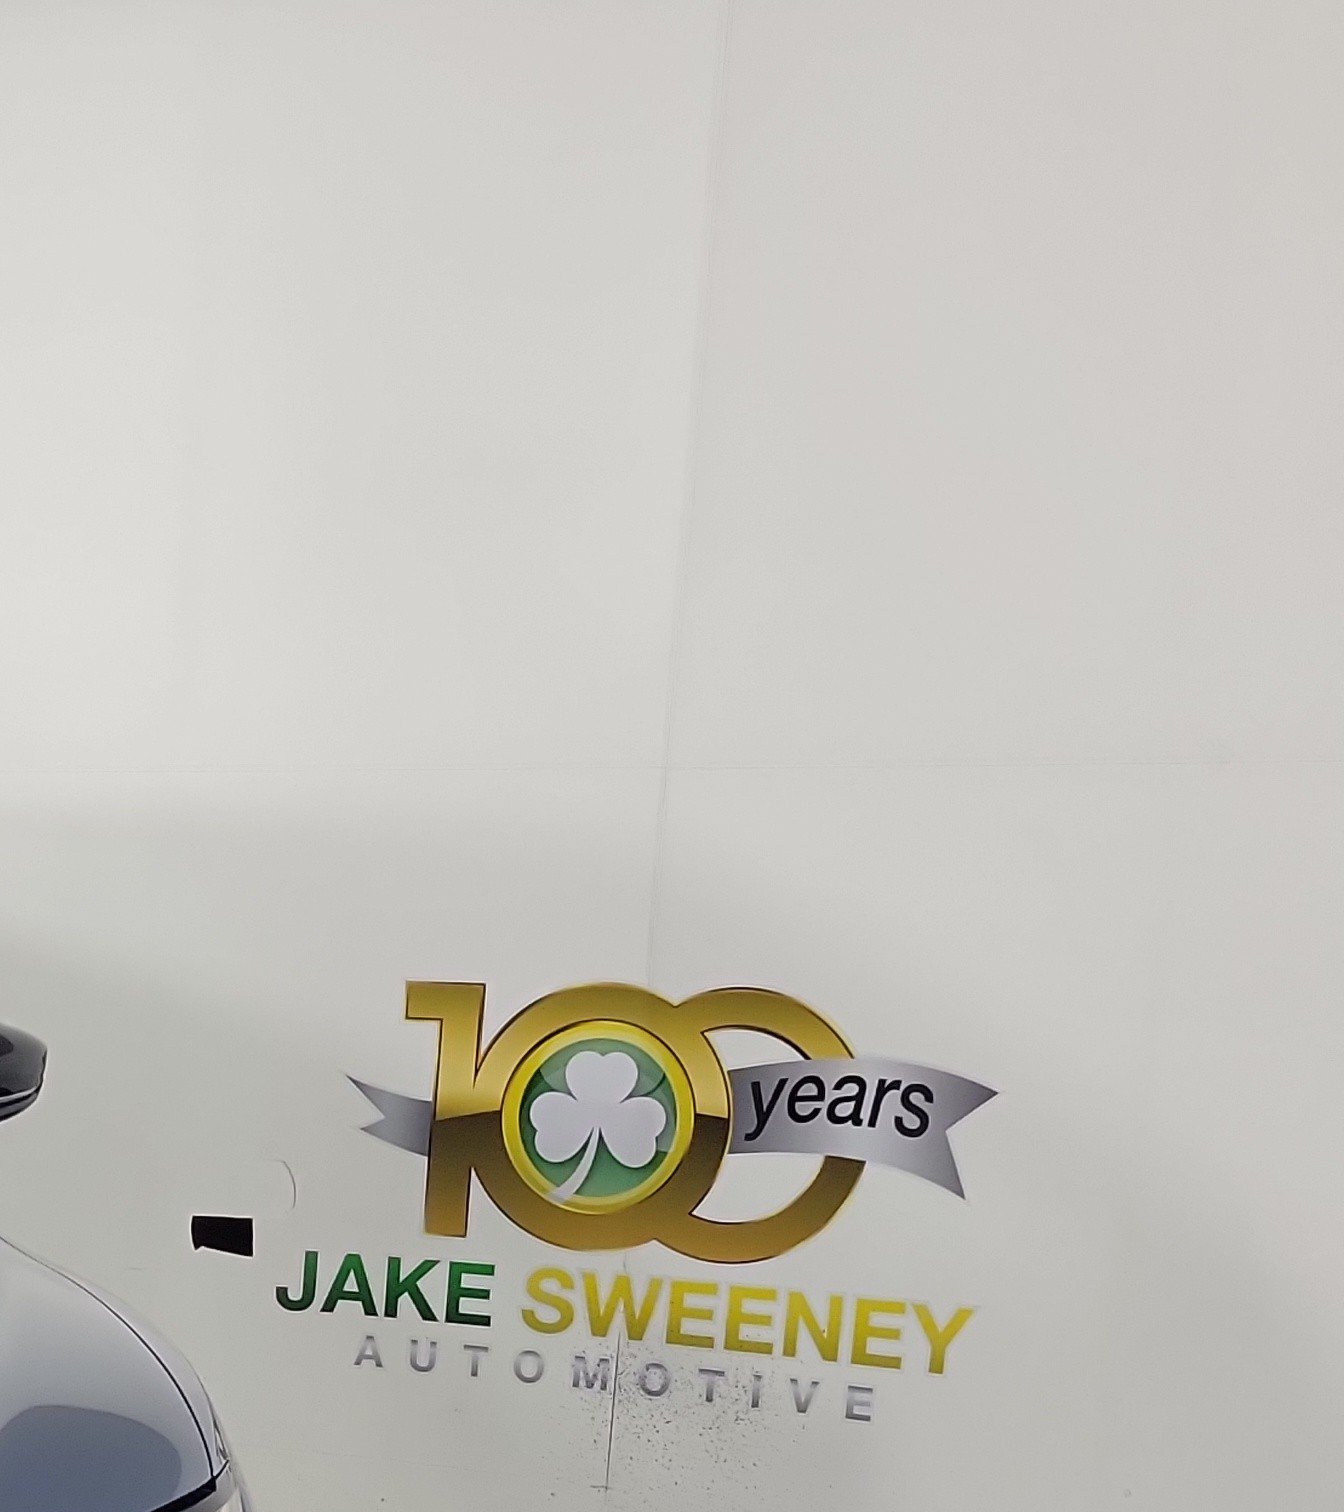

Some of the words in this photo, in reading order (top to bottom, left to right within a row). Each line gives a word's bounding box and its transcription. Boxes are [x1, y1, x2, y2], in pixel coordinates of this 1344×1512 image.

[405, 981, 866, 1264] 100
[743, 1074, 935, 1141] years
[276, 1250, 496, 1326] JAKE
[520, 1266, 975, 1376] SWEENEY
[353, 1334, 875, 1423] AUTOMOTIVE
